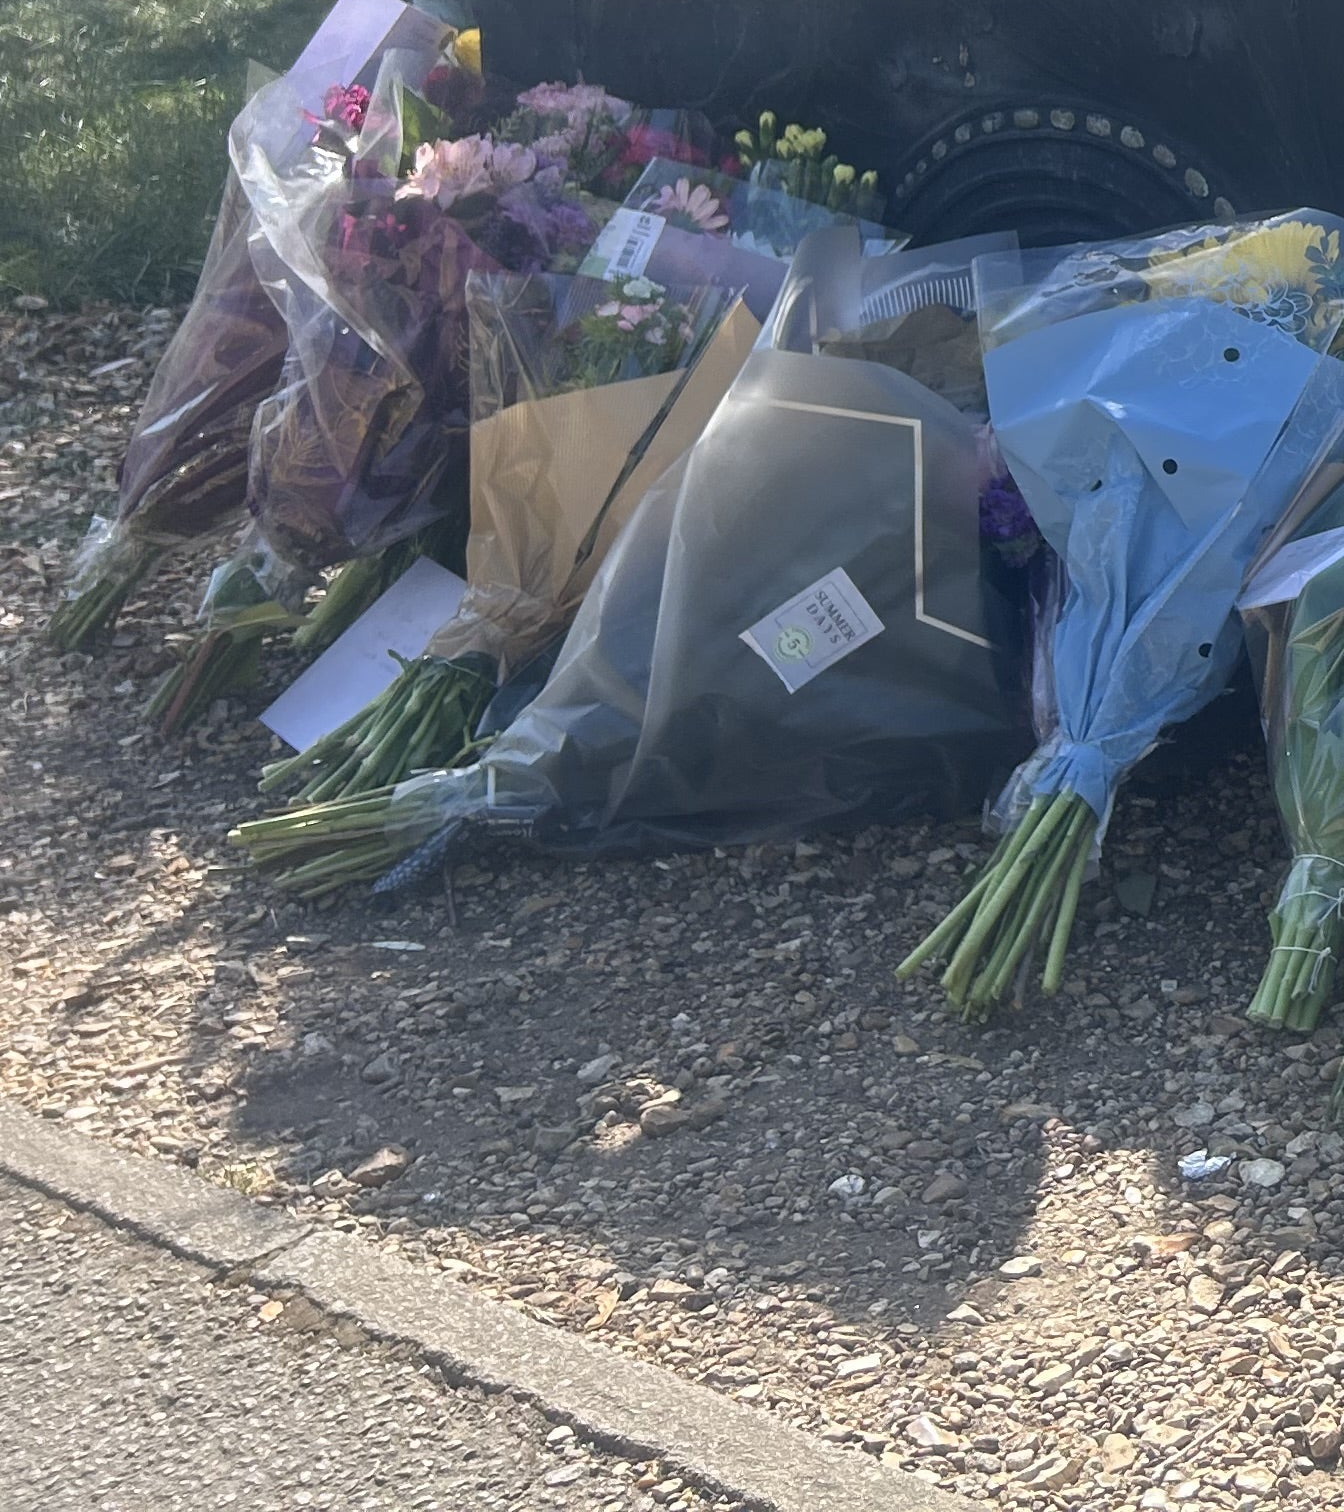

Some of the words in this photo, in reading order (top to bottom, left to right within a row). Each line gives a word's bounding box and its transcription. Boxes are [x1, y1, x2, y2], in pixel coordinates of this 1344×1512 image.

[806, 602, 842, 645] DAYS
[814, 590, 856, 642] SUMMER
[787, 638, 801, 650] 5
